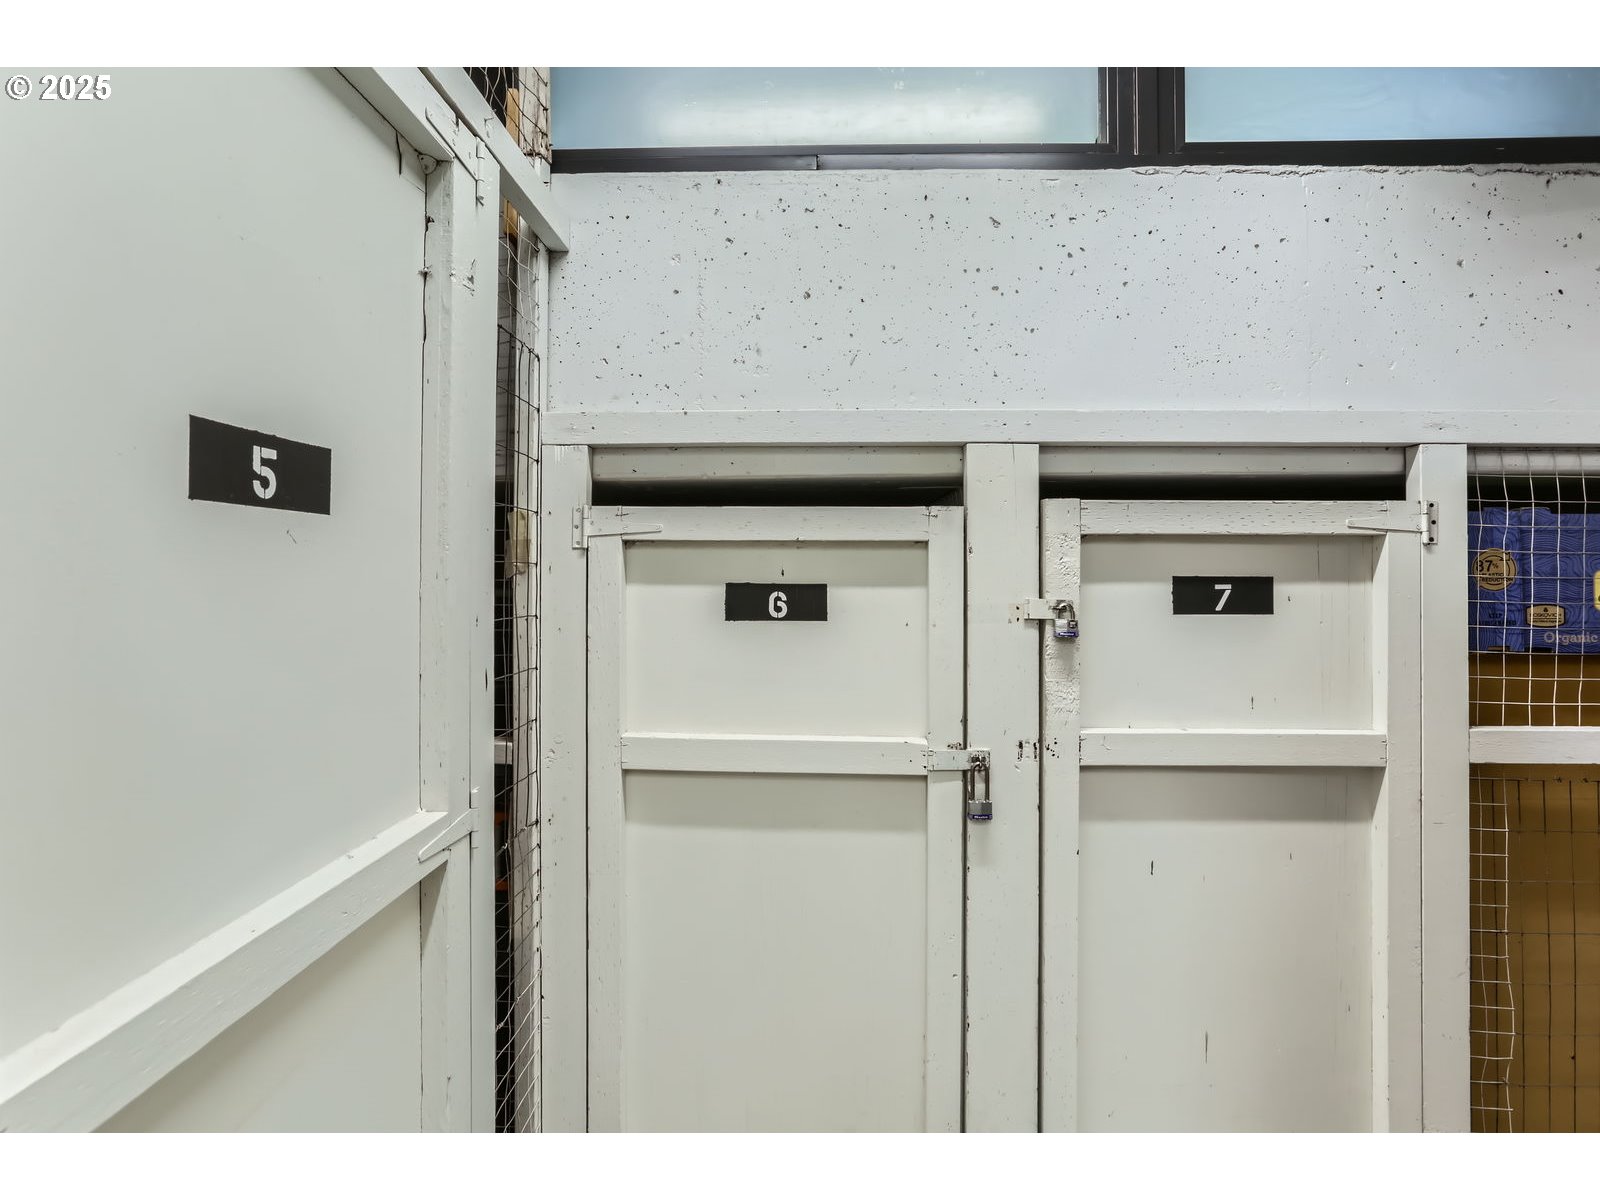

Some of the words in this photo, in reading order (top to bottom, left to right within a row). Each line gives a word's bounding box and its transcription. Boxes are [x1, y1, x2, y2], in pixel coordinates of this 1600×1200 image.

[252, 445, 277, 500] 5
[768, 591, 788, 618] 6
[1214, 584, 1232, 611] 7
[1544, 631, 1598, 645] Organic
